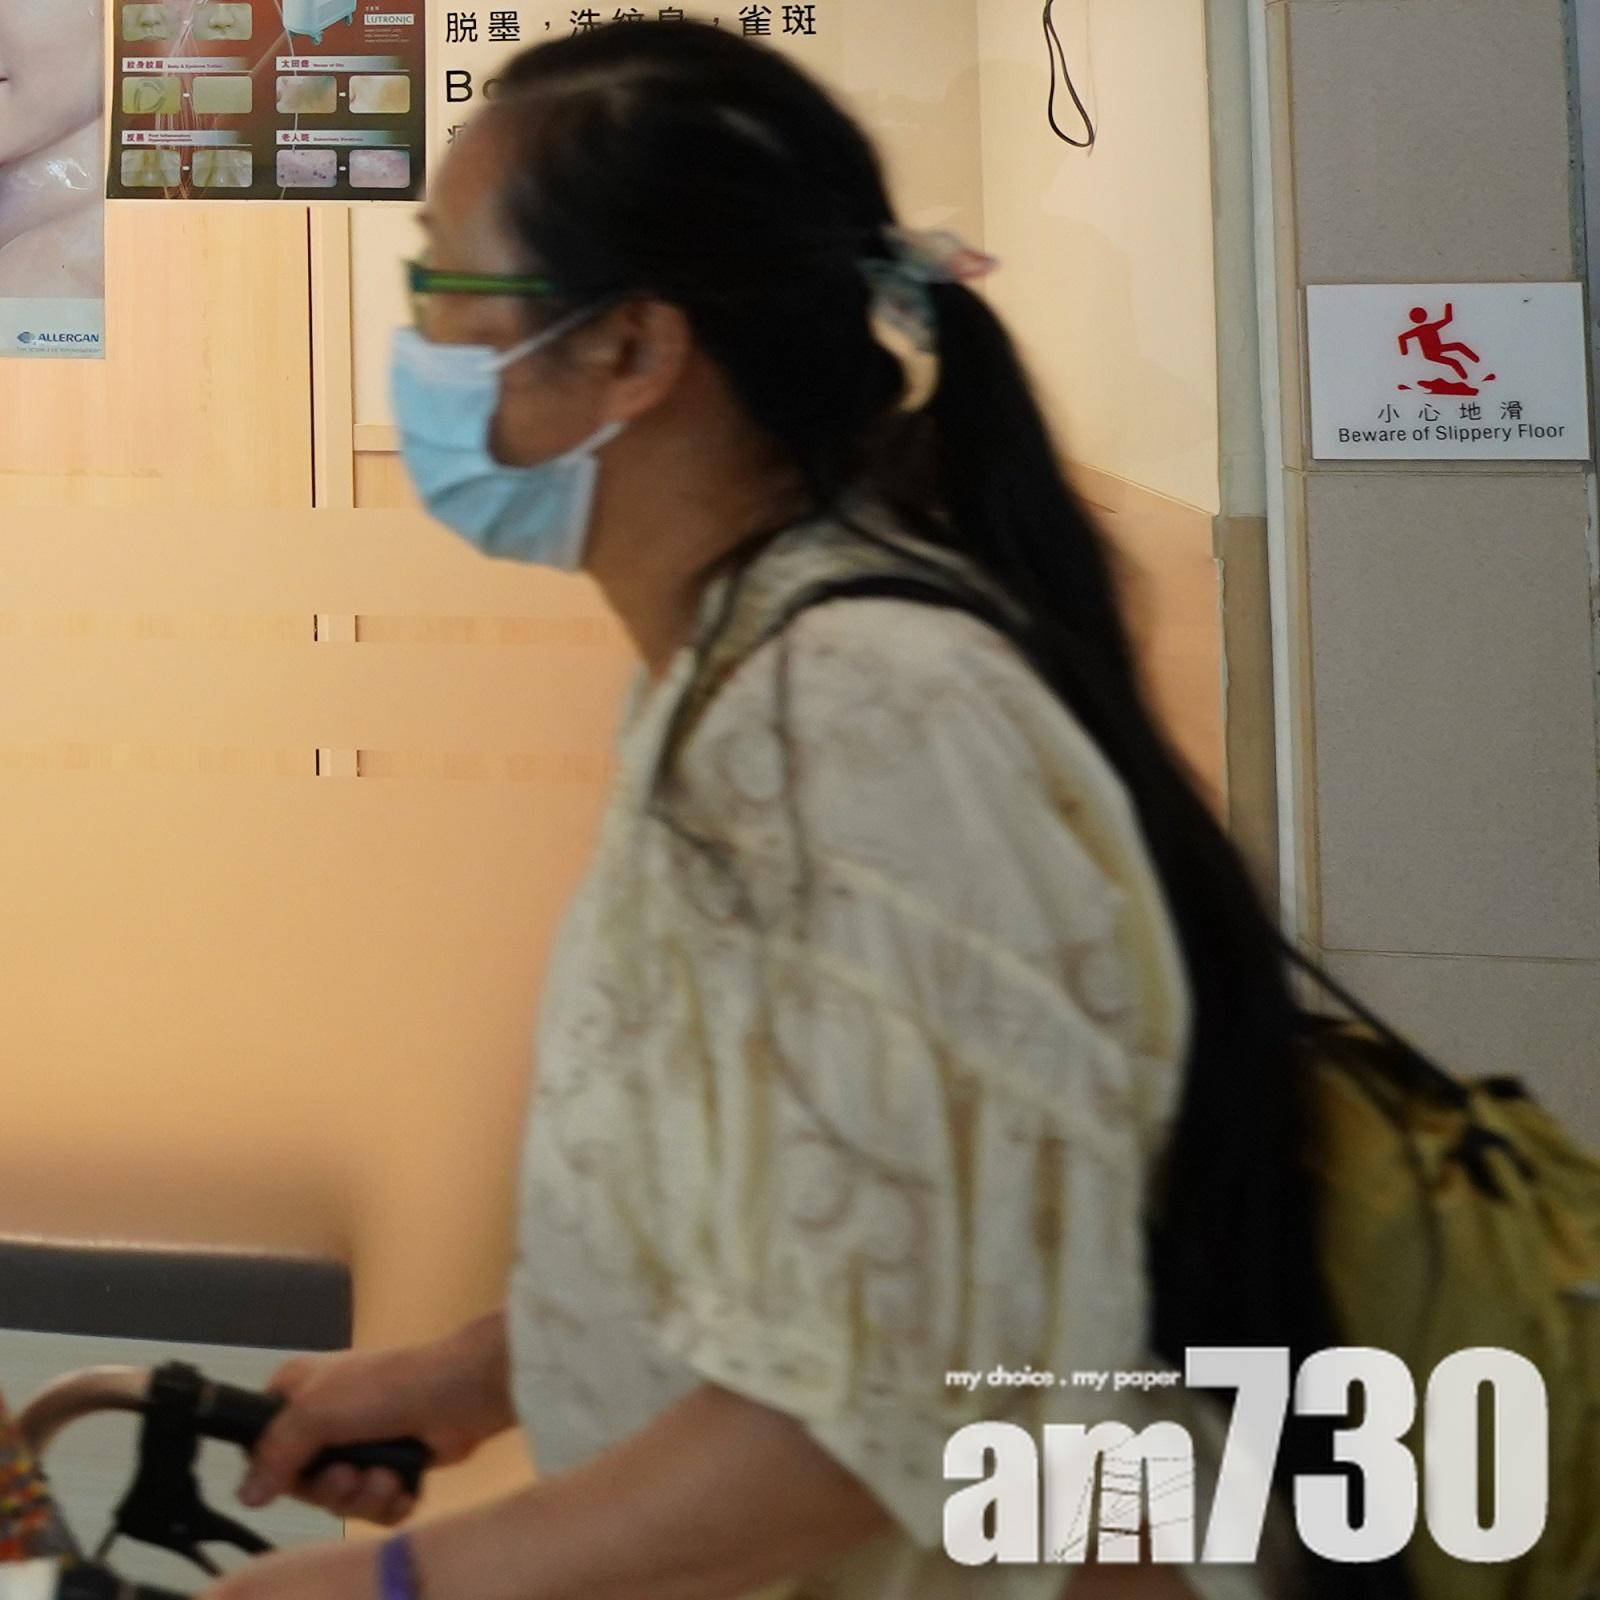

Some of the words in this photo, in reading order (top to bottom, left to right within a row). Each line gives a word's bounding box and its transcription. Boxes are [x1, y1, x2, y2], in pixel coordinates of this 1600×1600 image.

[366, 15, 412, 24] LUTRONIC
[38, 332, 100, 343] ALLERGAN
[1377, 401, 1523, 423] 小心地滑
[1338, 427, 1407, 443] Beware
[1412, 426, 1430, 441] of
[1435, 424, 1512, 443] Slippery
[1518, 423, 1565, 439] Floor
